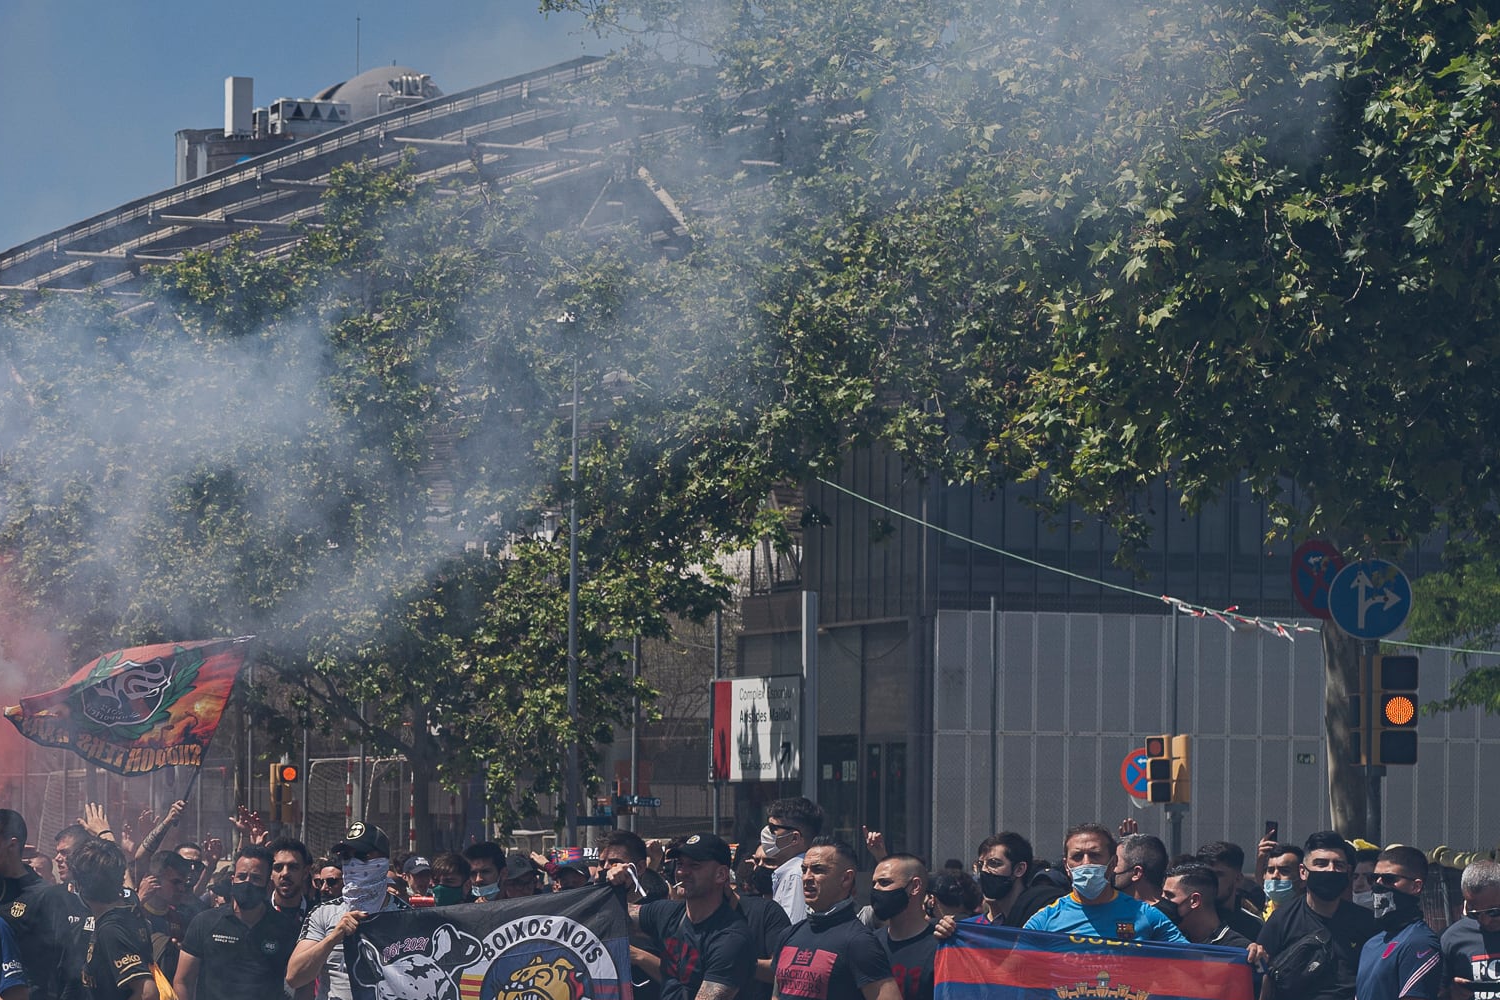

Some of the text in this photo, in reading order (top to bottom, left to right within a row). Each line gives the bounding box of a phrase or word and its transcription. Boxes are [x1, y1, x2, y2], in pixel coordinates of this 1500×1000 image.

[483, 918, 604, 964] BOIXOS NOIS
[114, 953, 141, 969] beko
